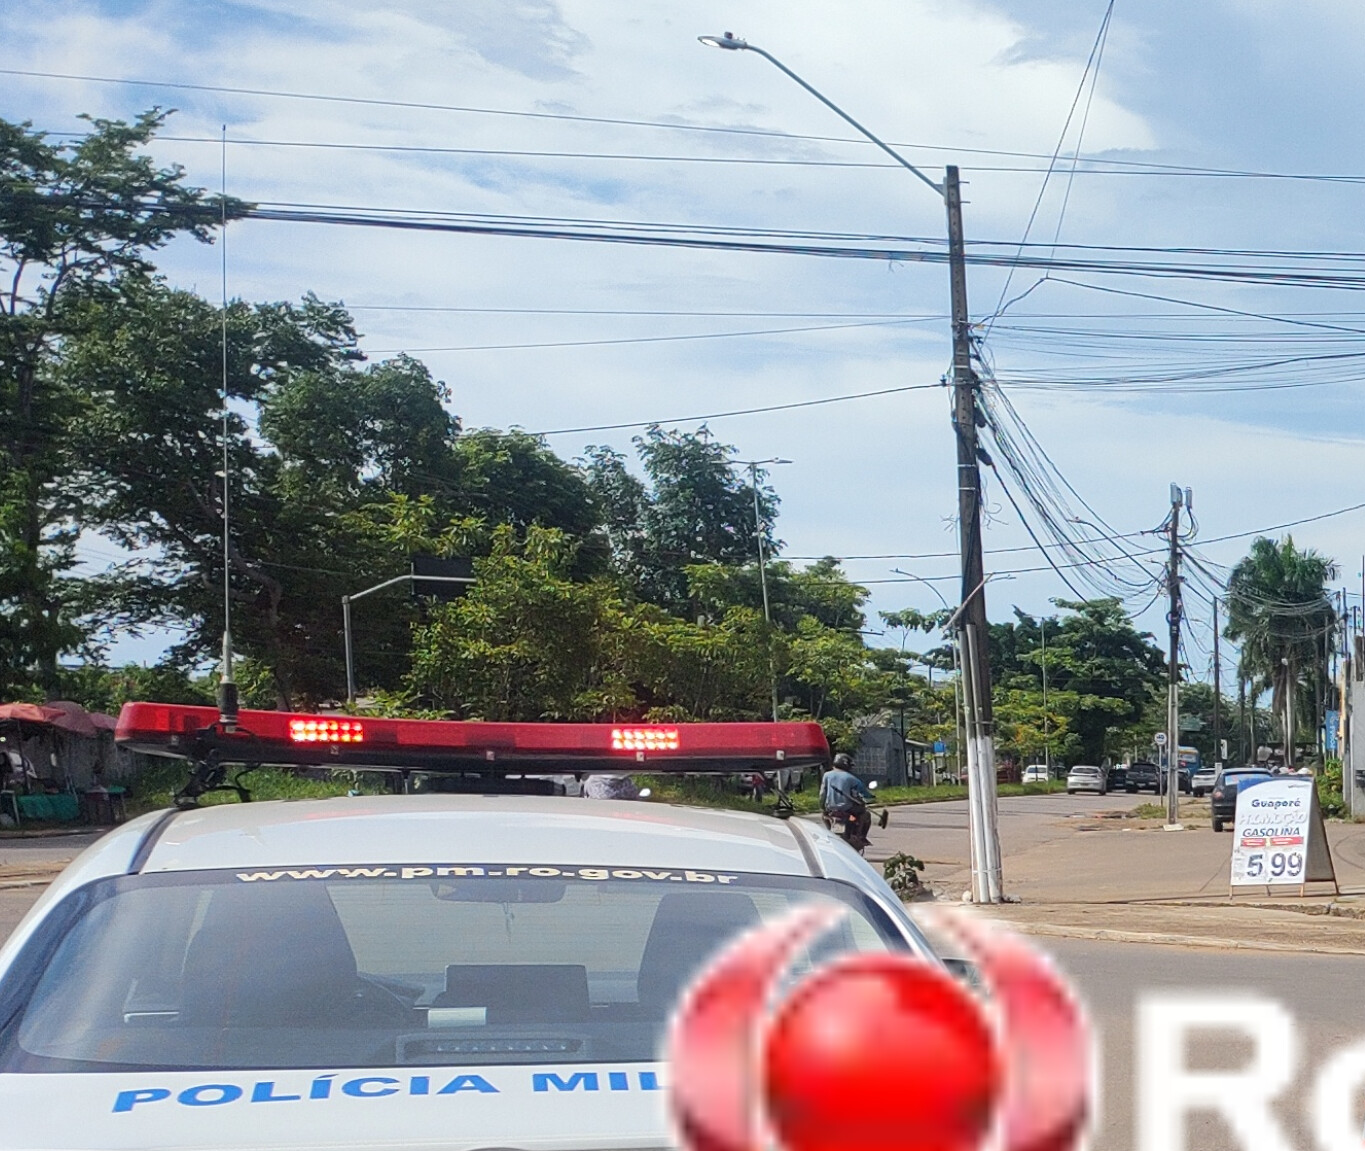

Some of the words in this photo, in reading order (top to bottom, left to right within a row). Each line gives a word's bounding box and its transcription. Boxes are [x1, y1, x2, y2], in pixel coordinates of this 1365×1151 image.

[1251, 798, 1301, 810] Guaporé
[1242, 827, 1301, 838] GASOLINA
[236, 864, 740, 885] www.pm.ro.gov.br
[111, 1073, 500, 1113] POLÍCIA
